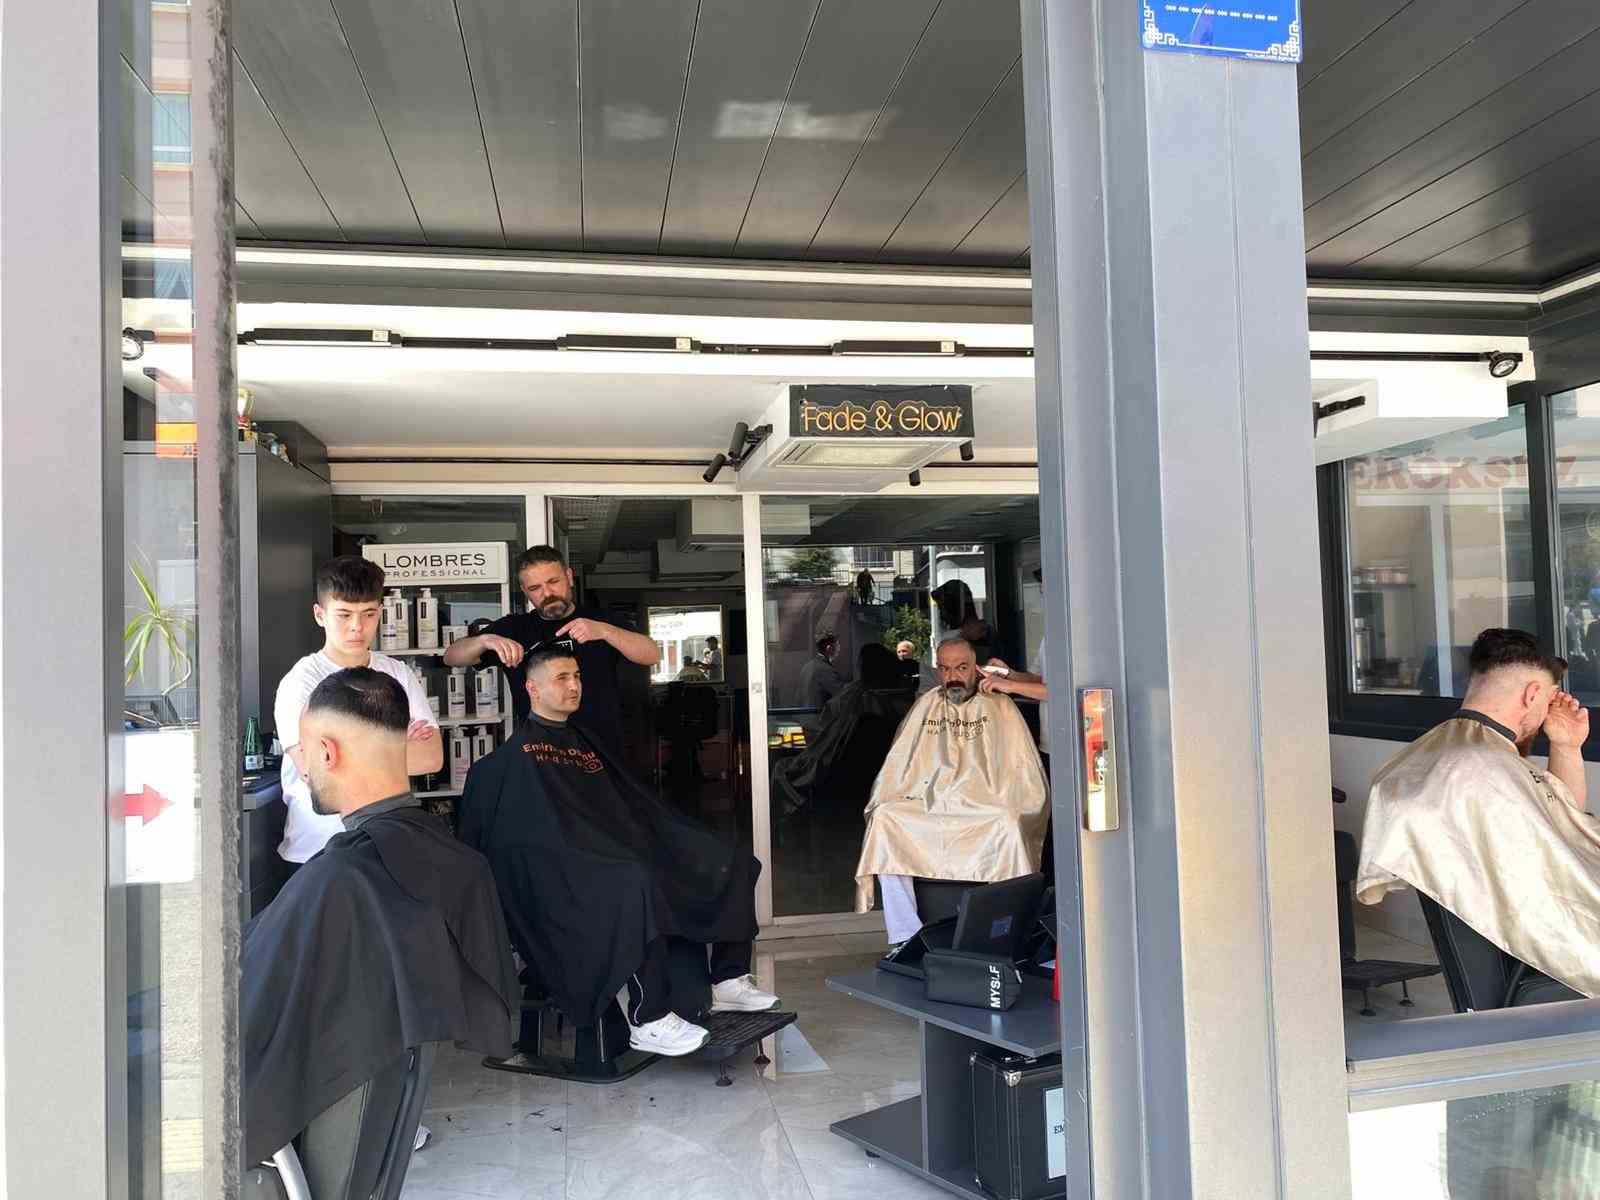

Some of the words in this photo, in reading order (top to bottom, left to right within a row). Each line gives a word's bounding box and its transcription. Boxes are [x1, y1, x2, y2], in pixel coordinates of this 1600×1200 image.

[803, 405, 866, 432] Fade
[875, 405, 893, 432] &
[899, 405, 961, 432] Glow
[383, 553, 486, 568] LOMBRES
[989, 965, 1001, 1008] MYSLF
